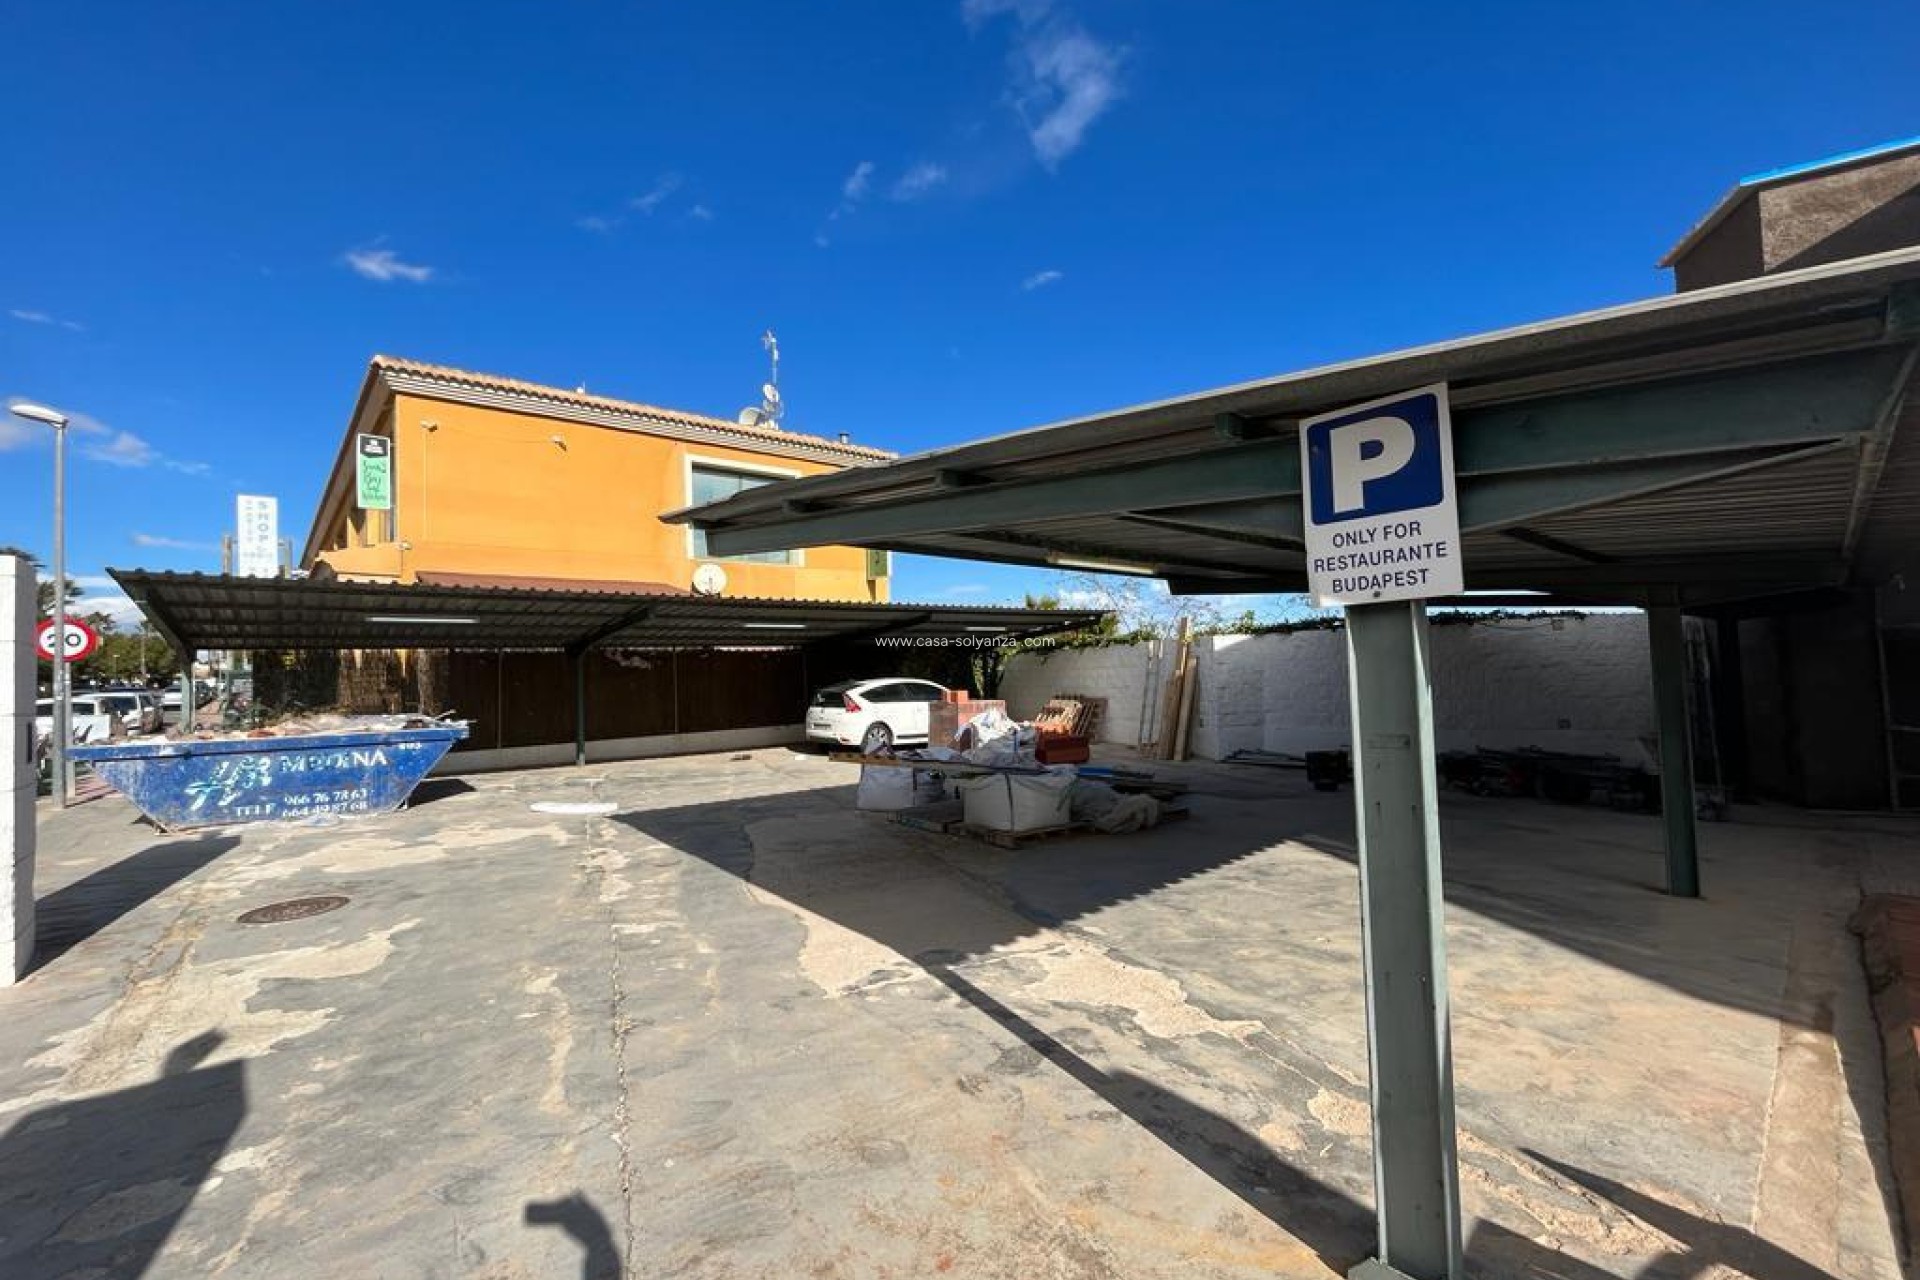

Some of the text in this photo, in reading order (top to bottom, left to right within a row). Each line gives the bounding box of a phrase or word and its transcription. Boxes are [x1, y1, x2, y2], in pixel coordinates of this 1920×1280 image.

[1329, 416, 1415, 514] P
[1332, 521, 1422, 549] ONLY FOR
[1313, 540, 1449, 574] RESTAURANTE
[1332, 568, 1430, 594] BUDAPEST
